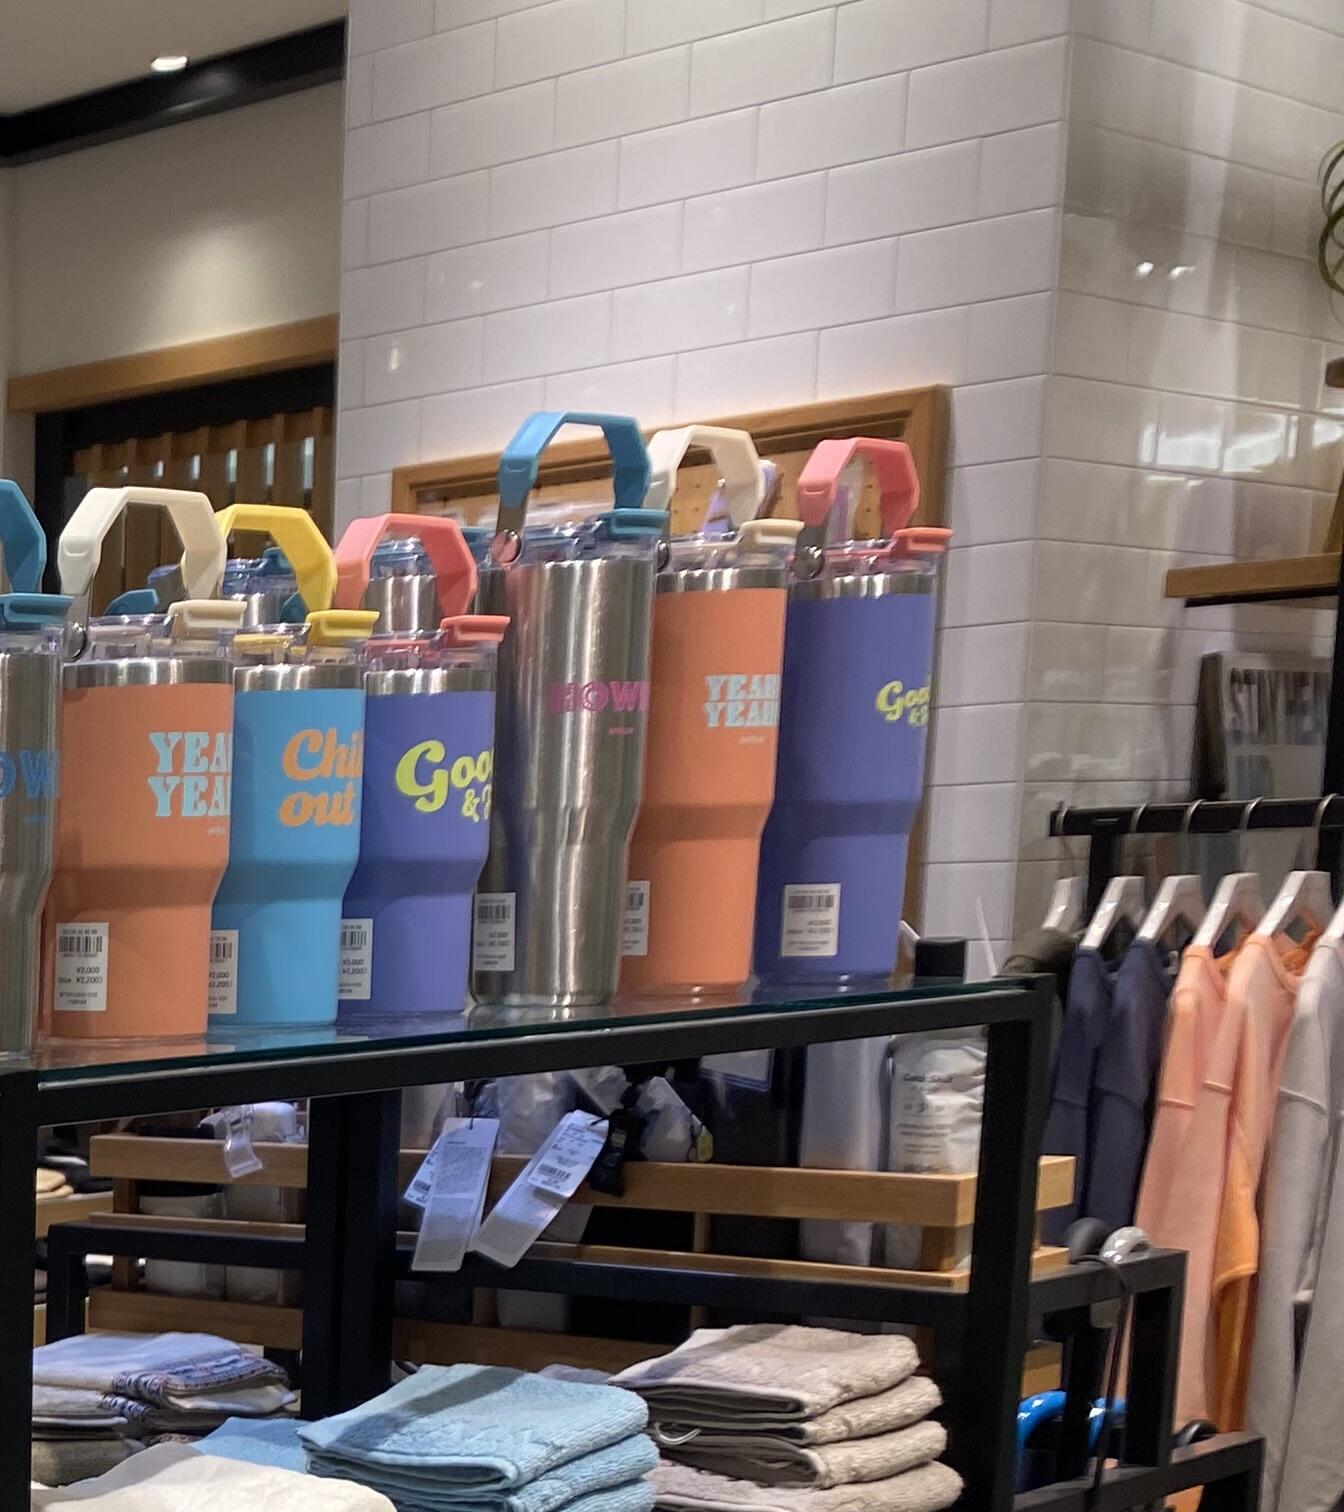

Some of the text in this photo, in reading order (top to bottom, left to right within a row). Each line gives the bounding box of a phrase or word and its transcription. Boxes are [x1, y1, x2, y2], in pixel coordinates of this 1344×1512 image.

[148, 732, 231, 773] YEA
[147, 776, 231, 817] YEA
[278, 790, 357, 828] out
